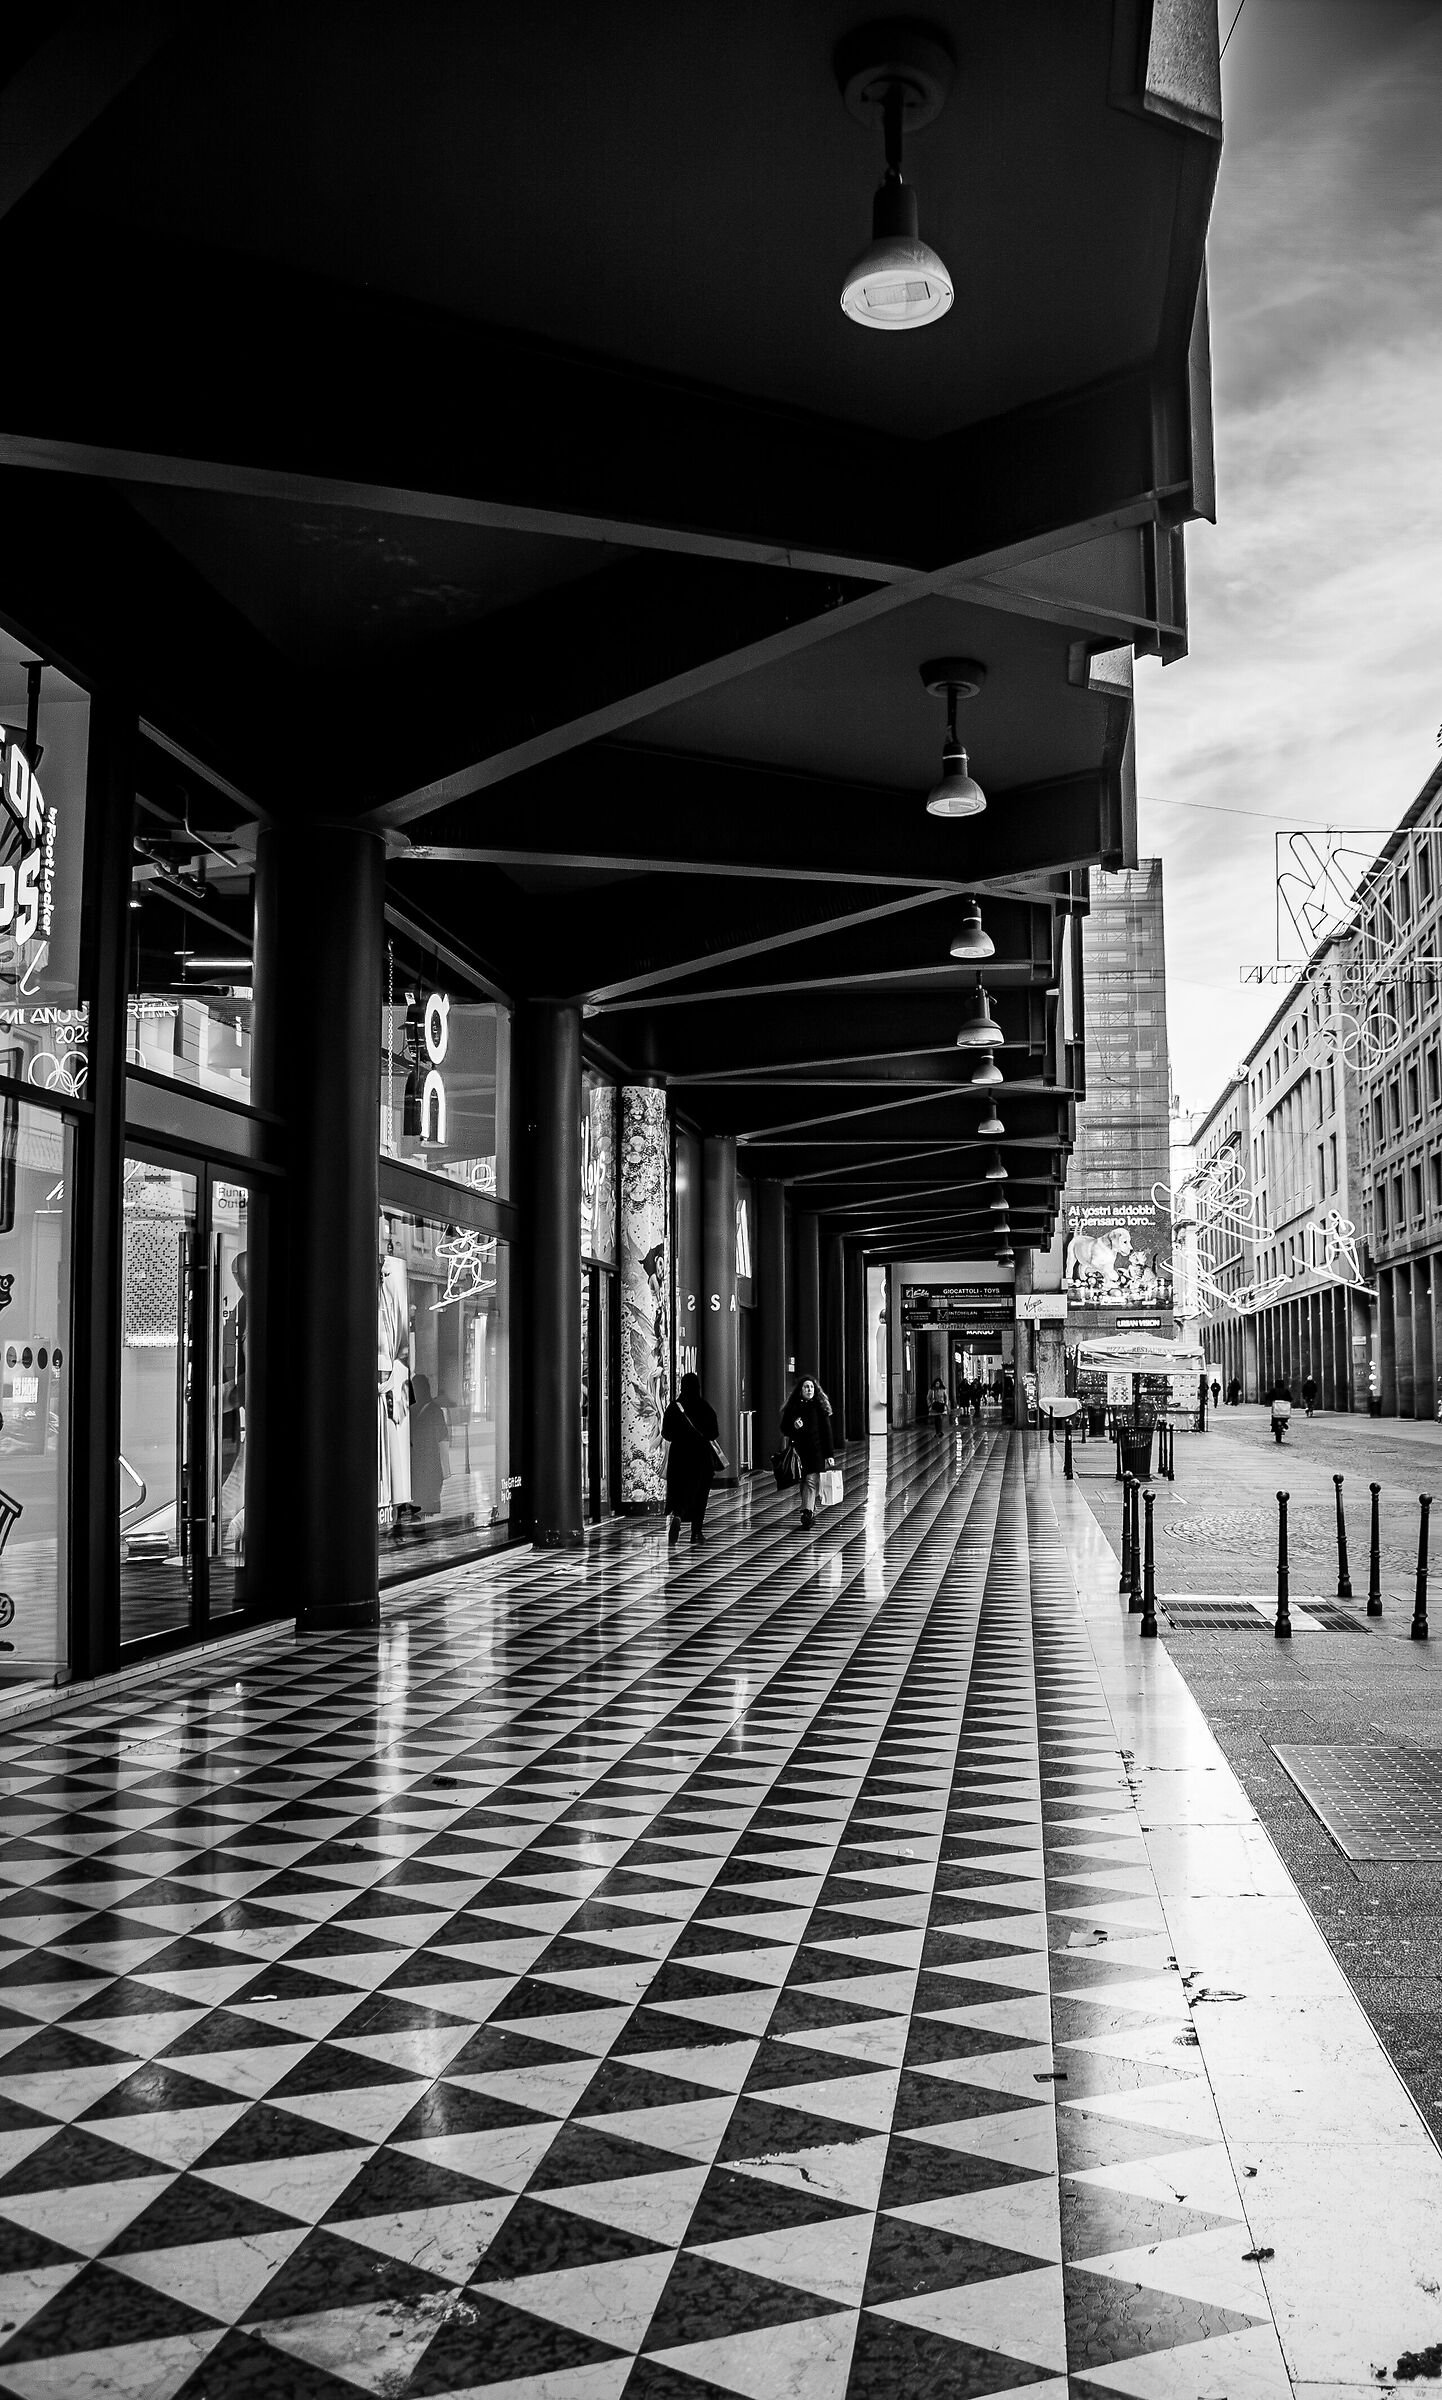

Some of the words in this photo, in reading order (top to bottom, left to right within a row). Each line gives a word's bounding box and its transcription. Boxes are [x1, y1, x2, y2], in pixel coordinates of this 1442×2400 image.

[1081, 1205, 1111, 1218] vostri
[1112, 1204, 1157, 1216] addobbi
[1080, 1217, 1126, 1229] pensano
